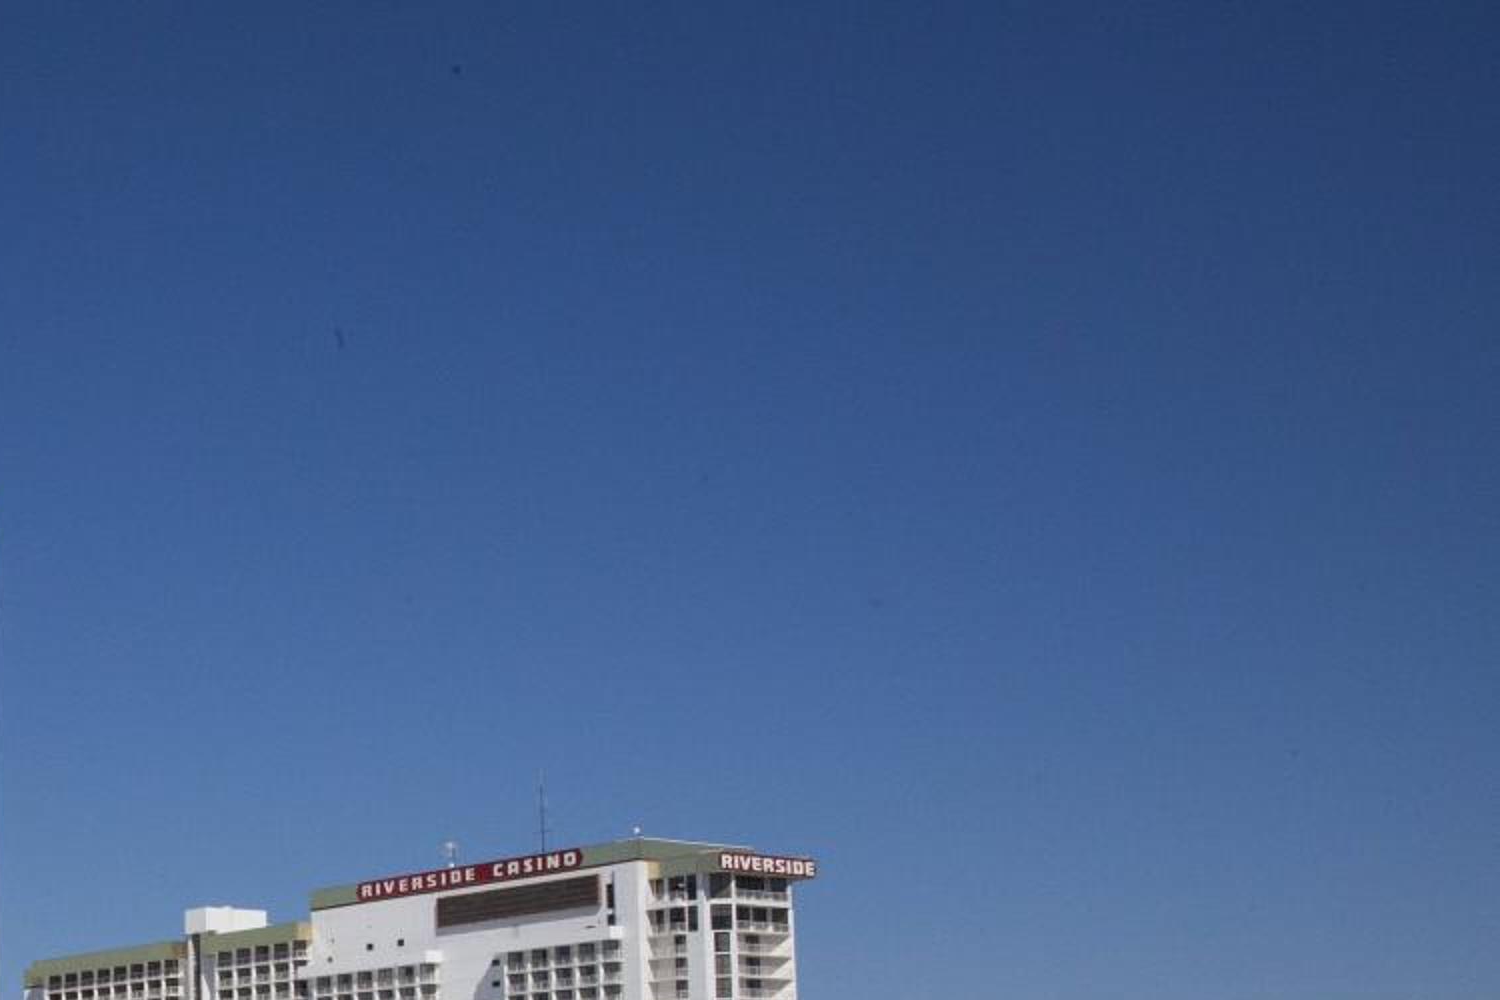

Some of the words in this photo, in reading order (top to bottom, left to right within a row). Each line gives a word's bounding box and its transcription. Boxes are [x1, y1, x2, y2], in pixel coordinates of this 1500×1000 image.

[361, 867, 476, 898] RIVERSIDE
[493, 851, 577, 878] CASINO
[721, 854, 815, 876] RIVERSIDE
